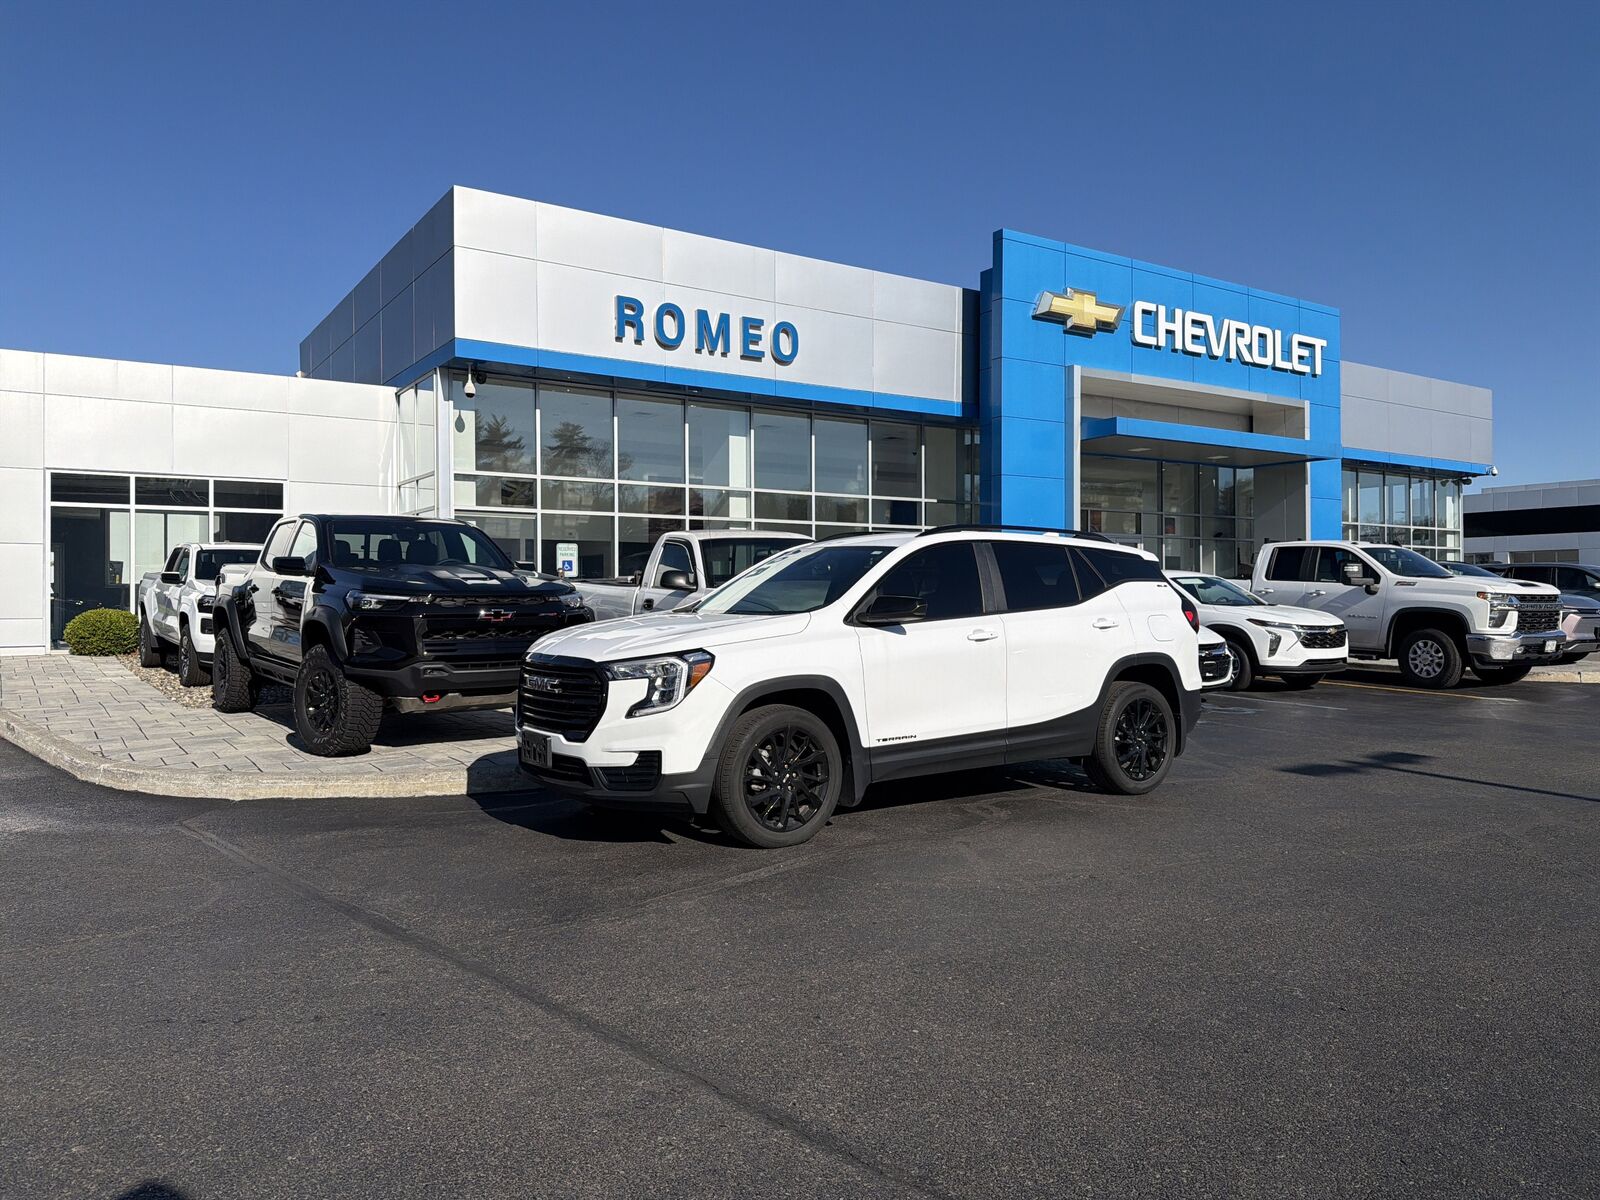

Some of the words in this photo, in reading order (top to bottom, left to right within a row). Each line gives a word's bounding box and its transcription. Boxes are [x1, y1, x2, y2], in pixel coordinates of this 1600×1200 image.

[615, 295, 799, 365] ROMEO
[1133, 300, 1327, 376] CHEVROLET
[526, 675, 561, 694] GMC
